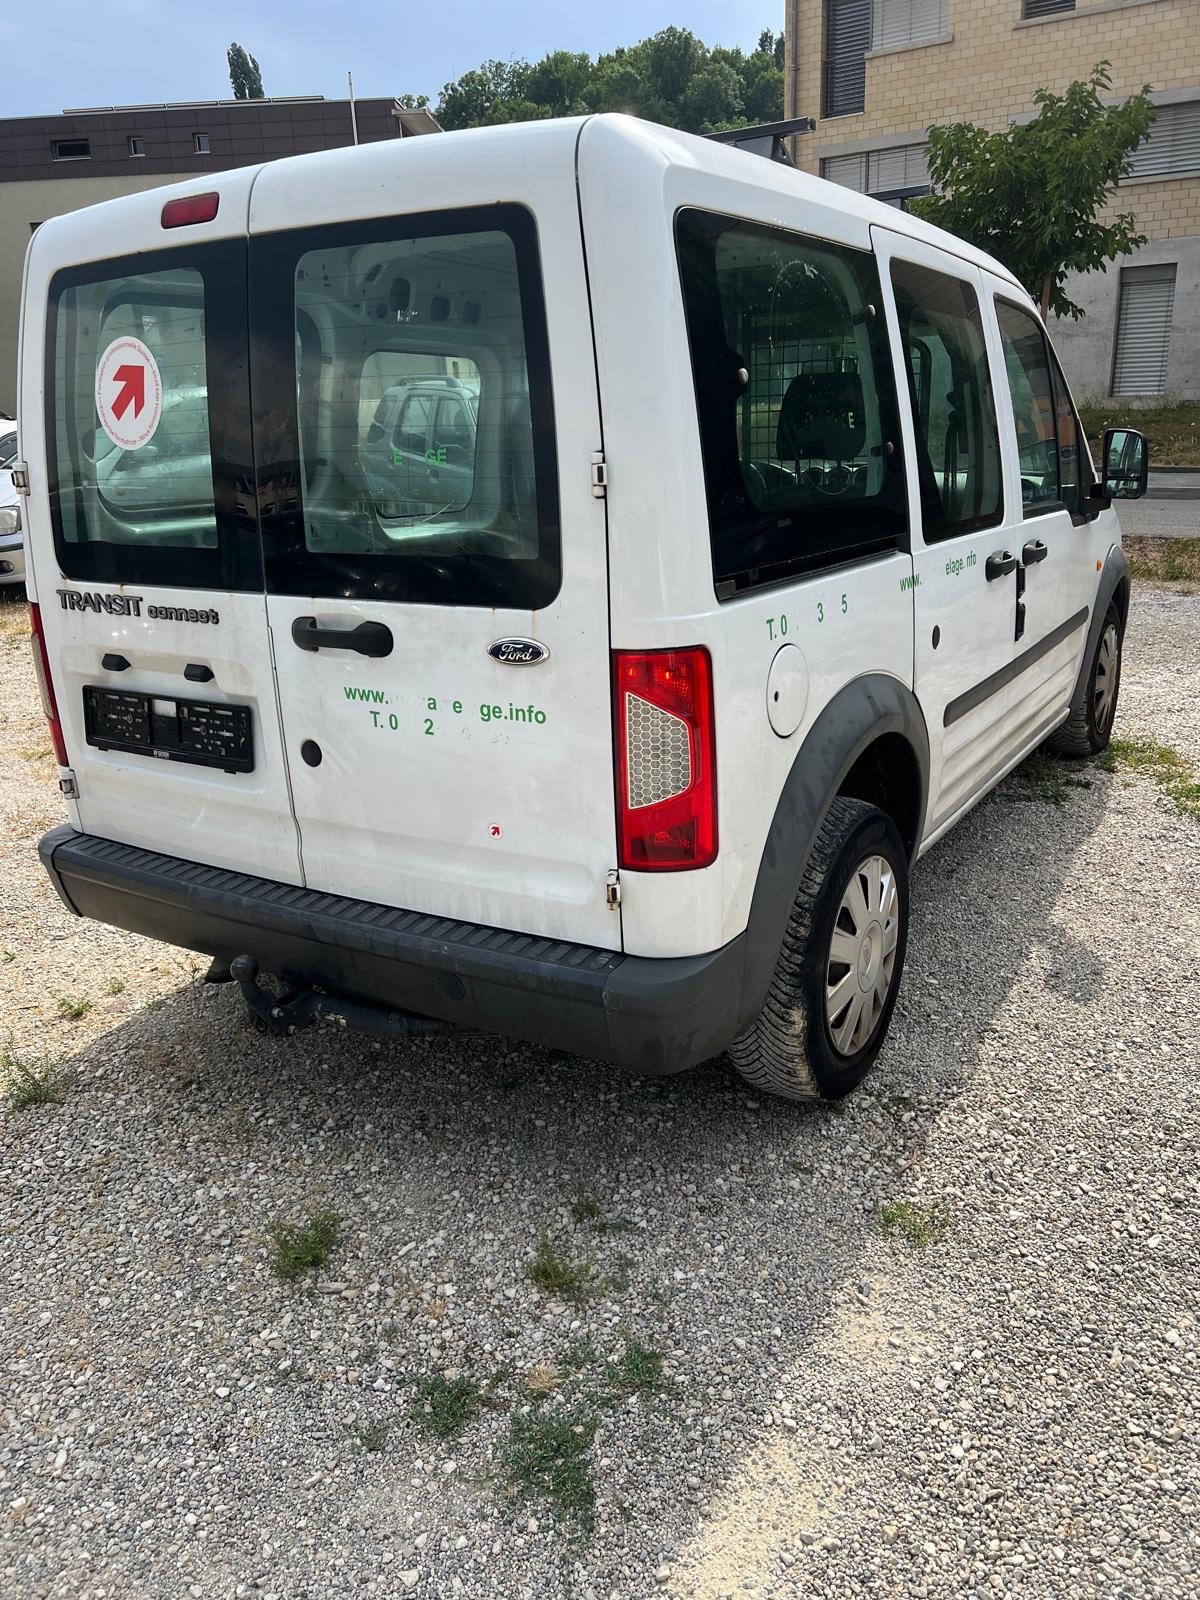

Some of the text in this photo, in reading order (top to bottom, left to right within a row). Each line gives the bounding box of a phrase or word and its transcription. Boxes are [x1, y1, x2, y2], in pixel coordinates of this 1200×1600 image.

[425, 448, 447, 465] GE
[56, 589, 220, 625] TRANSIT connect
[817, 602, 824, 623] 3
[841, 593, 848, 614] 5
[499, 643, 533, 660] Ford
[344, 686, 389, 704] www.
[479, 702, 547, 724] ge.info
[424, 718, 435, 735] 2
